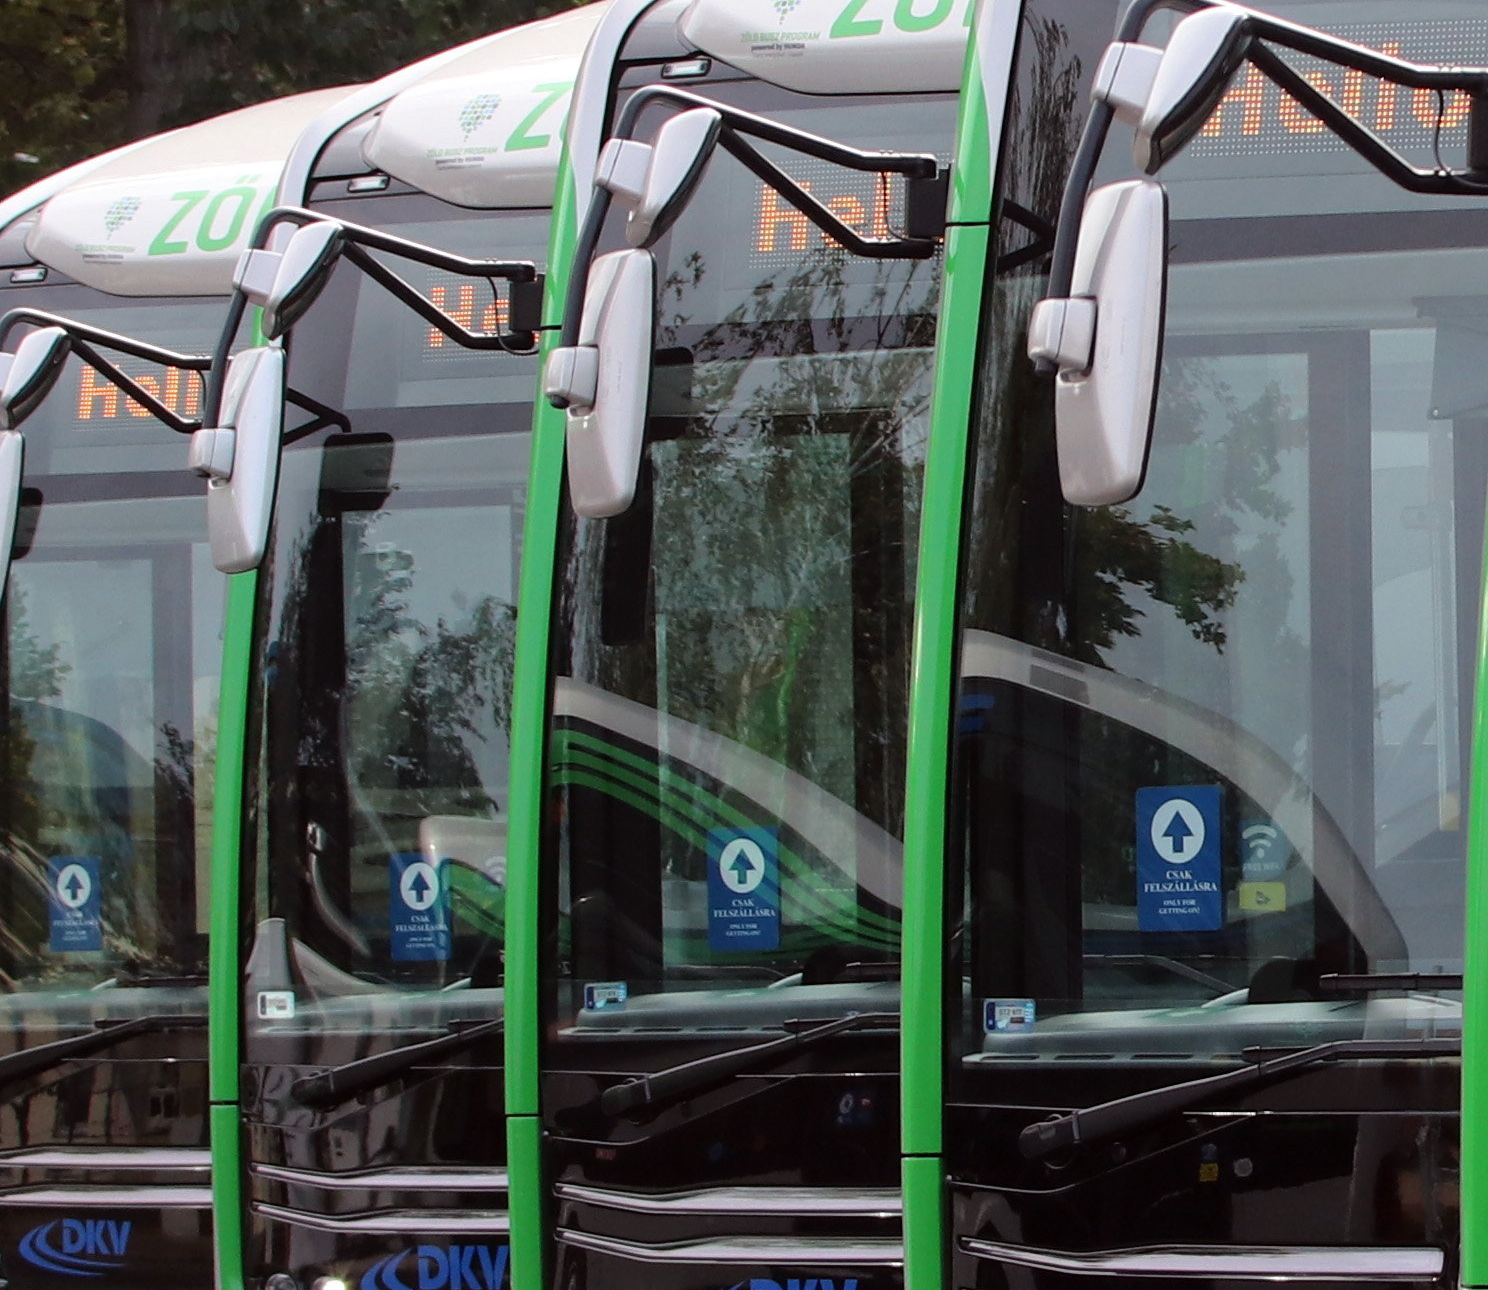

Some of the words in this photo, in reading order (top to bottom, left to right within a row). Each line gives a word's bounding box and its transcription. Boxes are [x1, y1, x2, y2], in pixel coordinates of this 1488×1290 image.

[147, 173, 278, 256] ZÖ
[757, 170, 893, 252] Hel
[78, 364, 202, 420] Hell
[1143, 879, 1219, 893] FELSZÁLLÁSRA
[1165, 869, 1193, 880] CSAK
[1182, 898, 1196, 906] FOR
[61, 1217, 132, 1256] DKV
